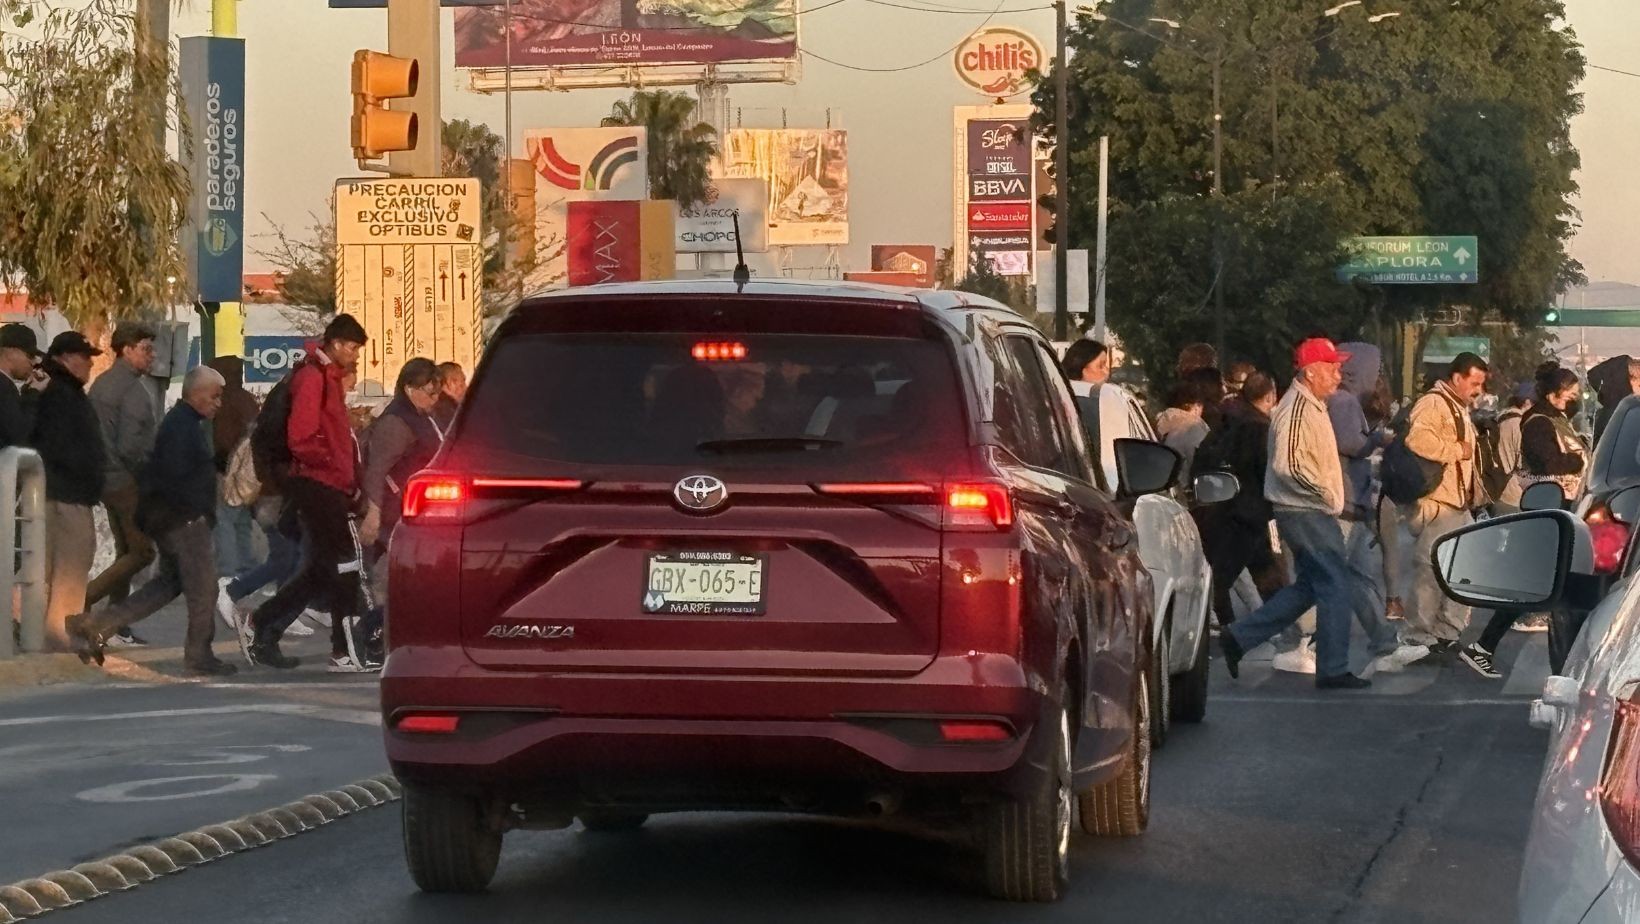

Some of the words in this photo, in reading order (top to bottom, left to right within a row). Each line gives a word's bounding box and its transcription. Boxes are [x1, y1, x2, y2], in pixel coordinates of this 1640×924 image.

[963, 41, 1033, 71] chili's
[204, 82, 224, 211] paraderos
[223, 108, 240, 211] seguros
[349, 184, 467, 196] PRECAUCION
[974, 178, 1025, 196] BBVA
[375, 196, 440, 210] CARRIL
[357, 210, 459, 223] EXCLUSIVO
[369, 224, 448, 236] OPTIBUS
[593, 220, 619, 283] MAX
[1417, 241, 1449, 253] LEON
[651, 567, 760, 596] GBX-065-E
[670, 603, 711, 613] MARPE
[484, 625, 575, 638] AVANZA
